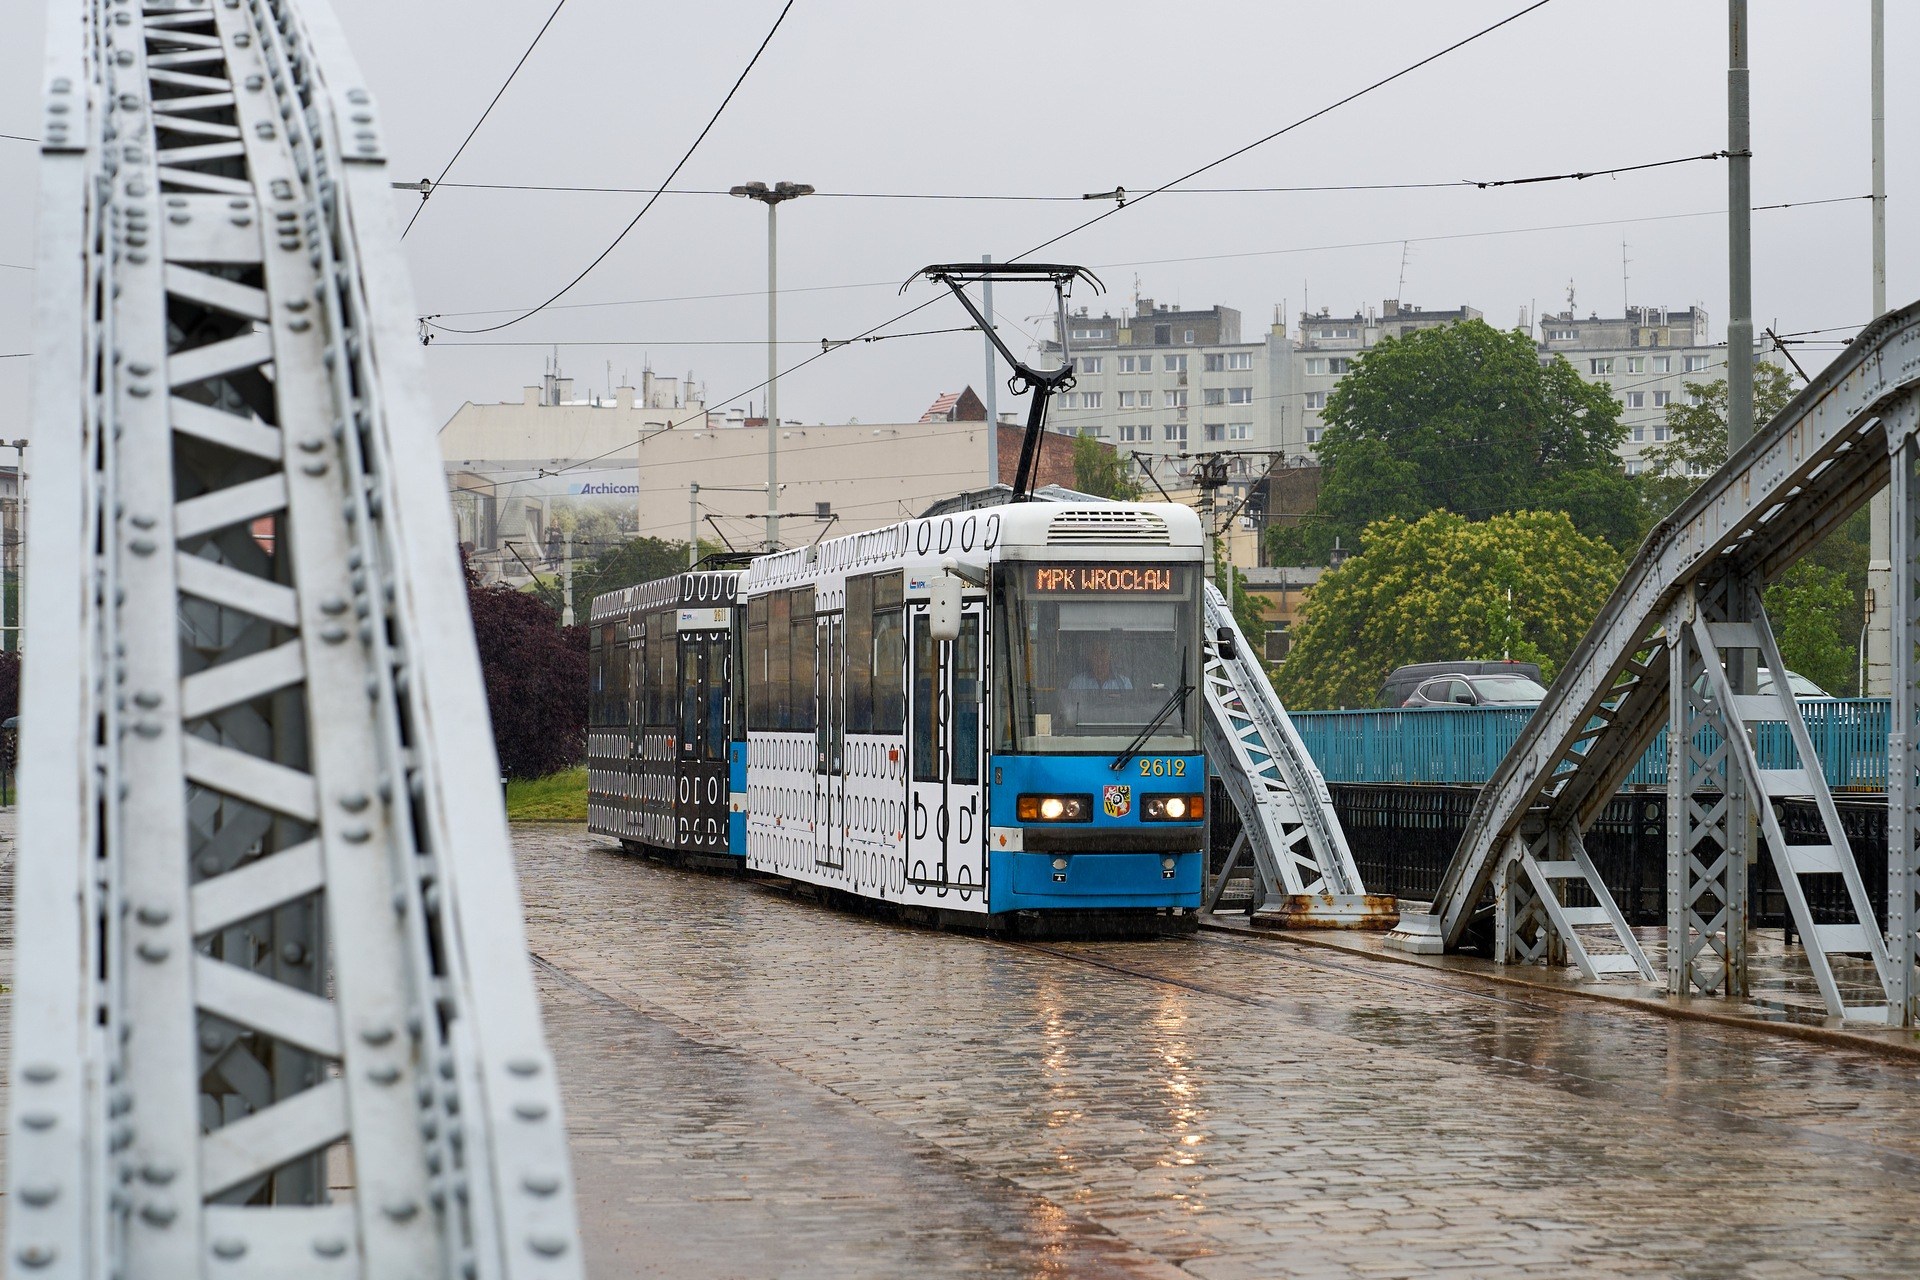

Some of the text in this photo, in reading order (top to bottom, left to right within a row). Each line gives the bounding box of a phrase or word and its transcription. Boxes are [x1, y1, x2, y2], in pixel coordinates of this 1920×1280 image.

[580, 483, 639, 494] Archicom
[1038, 569, 1170, 590] MPK WROCŁAW
[1140, 759, 1186, 777] 2612
